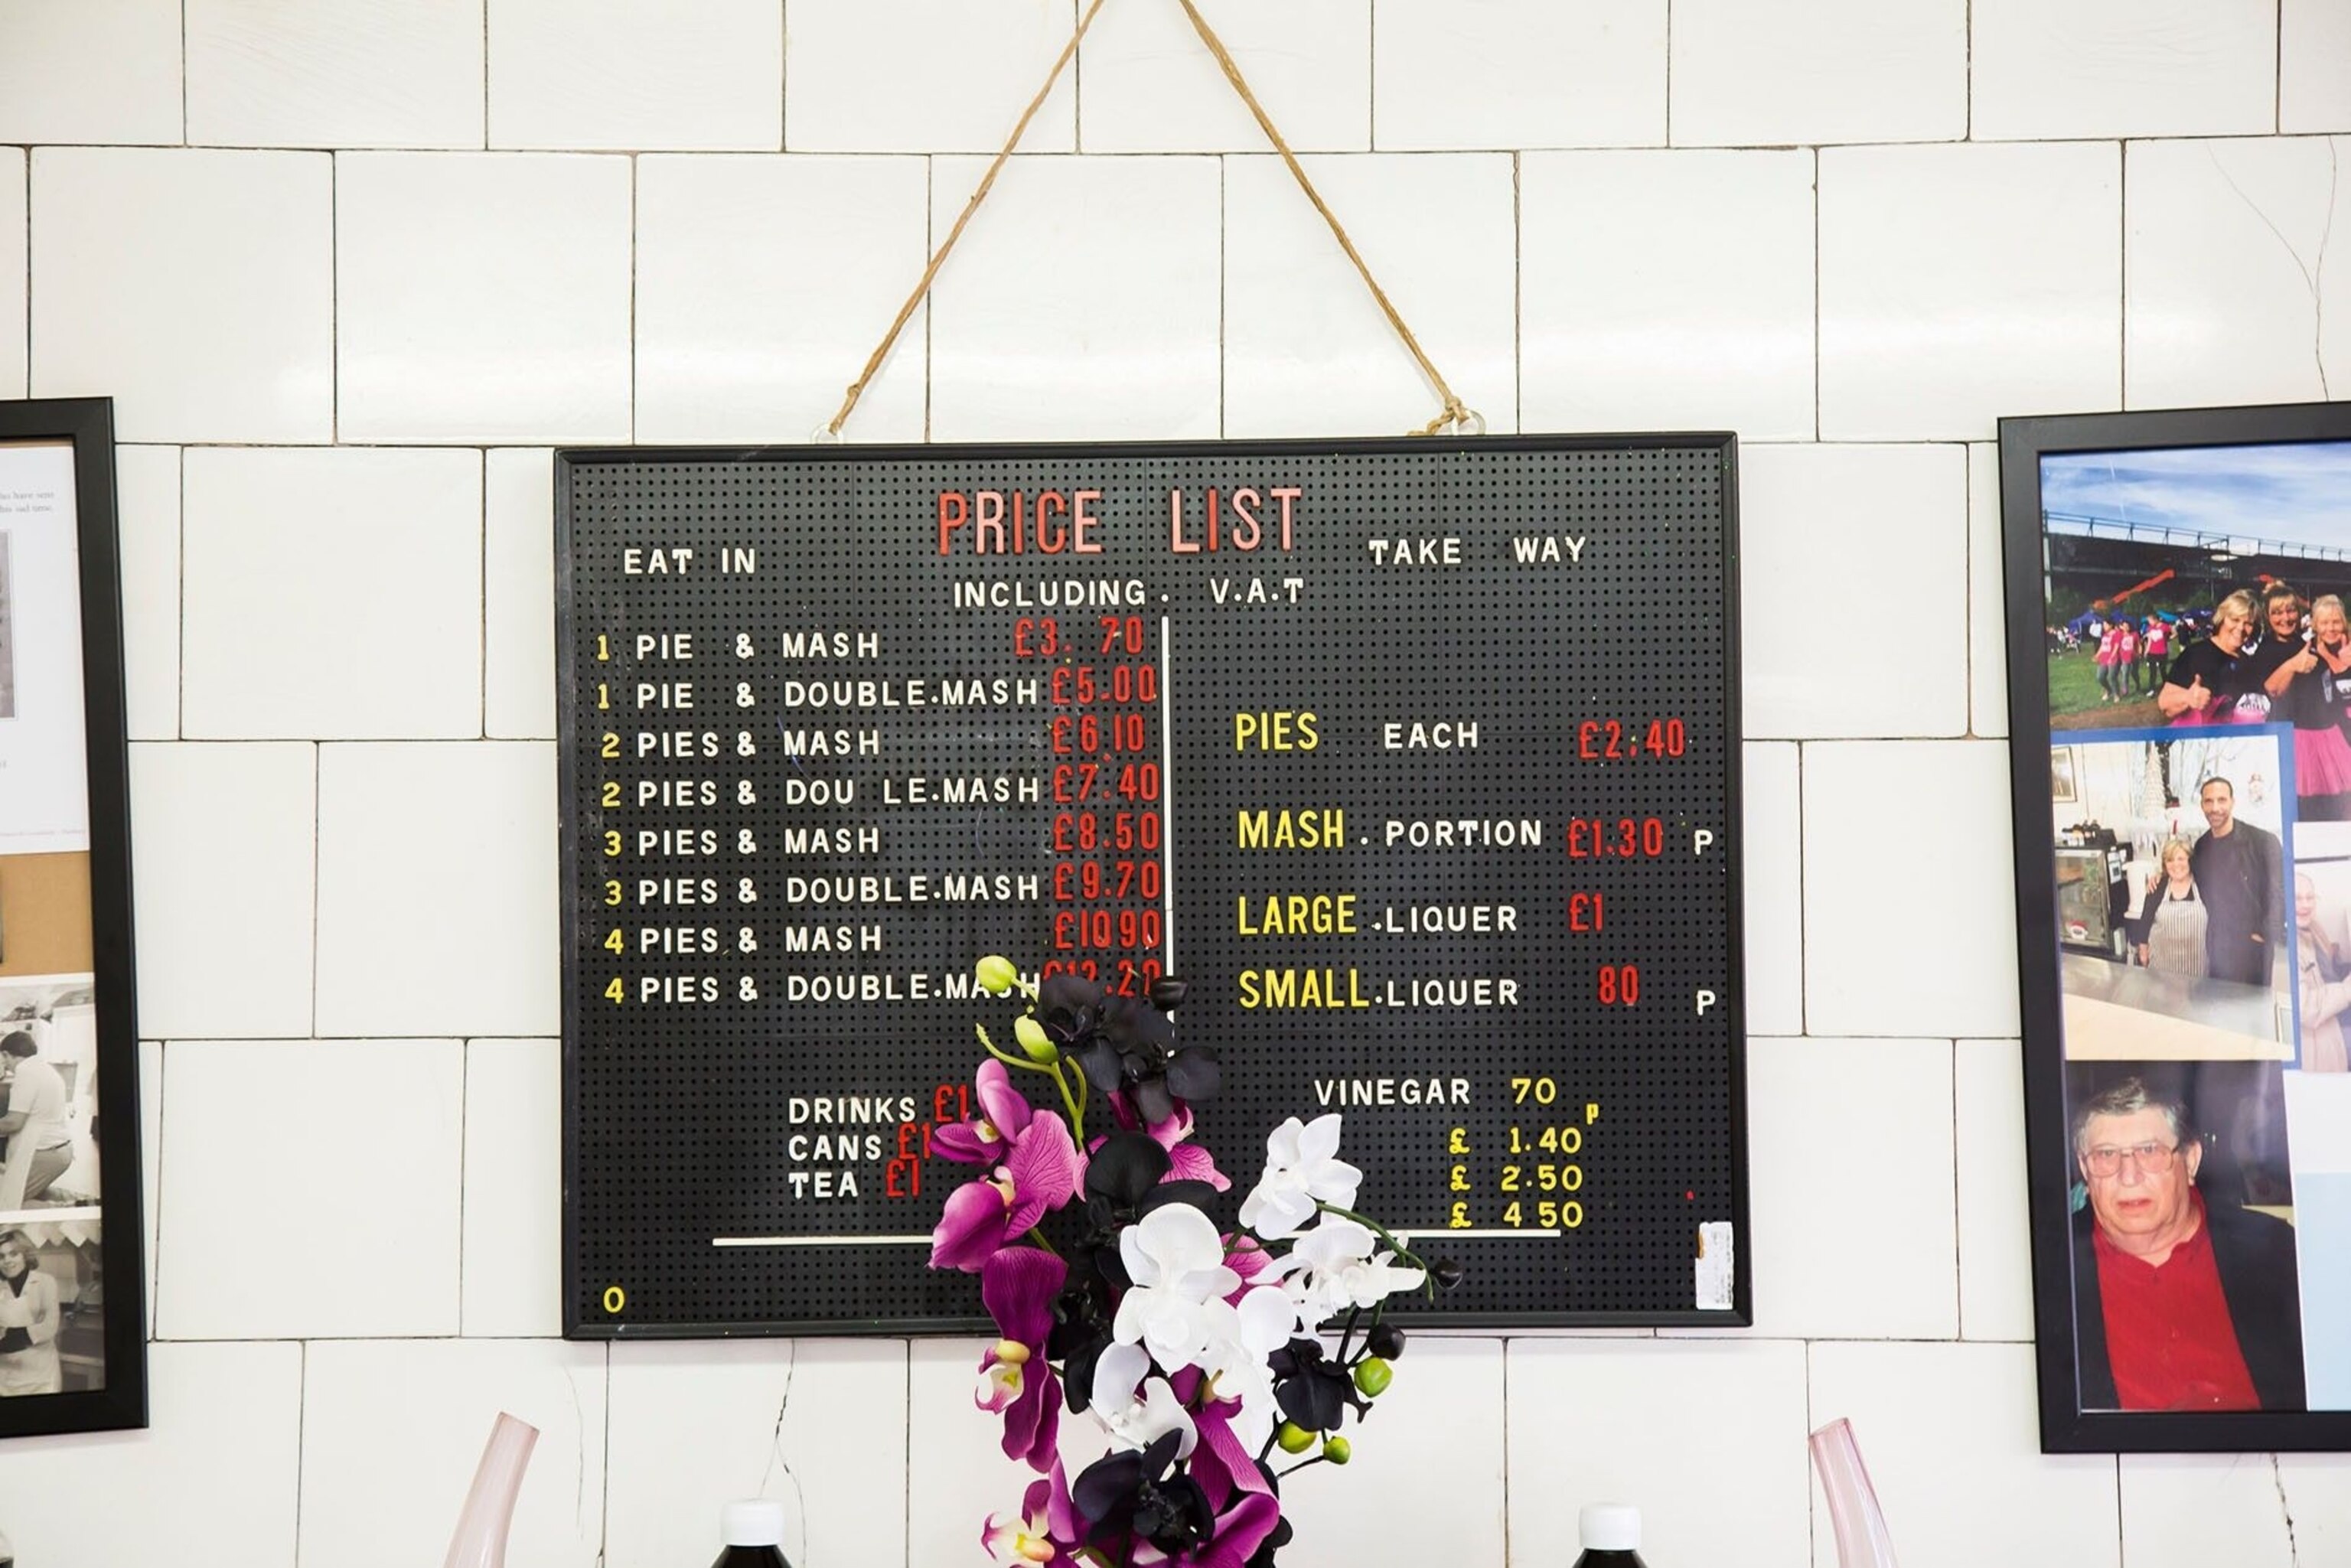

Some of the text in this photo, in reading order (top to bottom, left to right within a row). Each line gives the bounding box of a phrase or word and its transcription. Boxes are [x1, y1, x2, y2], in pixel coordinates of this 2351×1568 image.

[939, 487, 1303, 556] PRICE LIST
[624, 547, 755, 575] EAT IN
[1368, 536, 1586, 566] TAKE WAY
[1210, 578, 1305, 604] V.A.T
[598, 634, 609, 660] 1
[637, 633, 693, 660] PIE
[735, 633, 755, 660] &
[782, 632, 879, 659] MASH
[598, 683, 609, 709] 1
[637, 683, 693, 709] PIE
[736, 682, 755, 708] &
[602, 732, 621, 758] 2
[637, 732, 719, 758] PIES
[737, 731, 756, 757] &
[784, 729, 880, 756] MASH
[1236, 712, 1684, 759] PIES EACH £2.40
[602, 781, 621, 807] 2
[639, 781, 717, 807] PIES
[737, 780, 756, 805] &
[605, 811, 1159, 856] 3 PIES & MASH £8.50
[1386, 820, 1541, 847] PORTION
[1567, 817, 1664, 858] £1.30
[605, 880, 621, 906] 3
[639, 878, 719, 905] PIES
[739, 878, 757, 903] &
[1054, 860, 1160, 901] £9.70
[1569, 892, 1603, 931] £1
[604, 928, 624, 955] 4
[641, 927, 719, 954] PIES
[739, 927, 757, 954] &
[786, 925, 882, 952] MASH
[605, 978, 624, 1004] 4
[641, 977, 719, 1003] PIES
[739, 976, 758, 1002] &
[1599, 964, 1639, 1005] 80
[789, 1084, 969, 1123] DRINKS £1
[1314, 1077, 1556, 1106] VINEGAR 70
[788, 1122, 931, 1162] CANS £1
[788, 1159, 920, 1199] TEA £1
